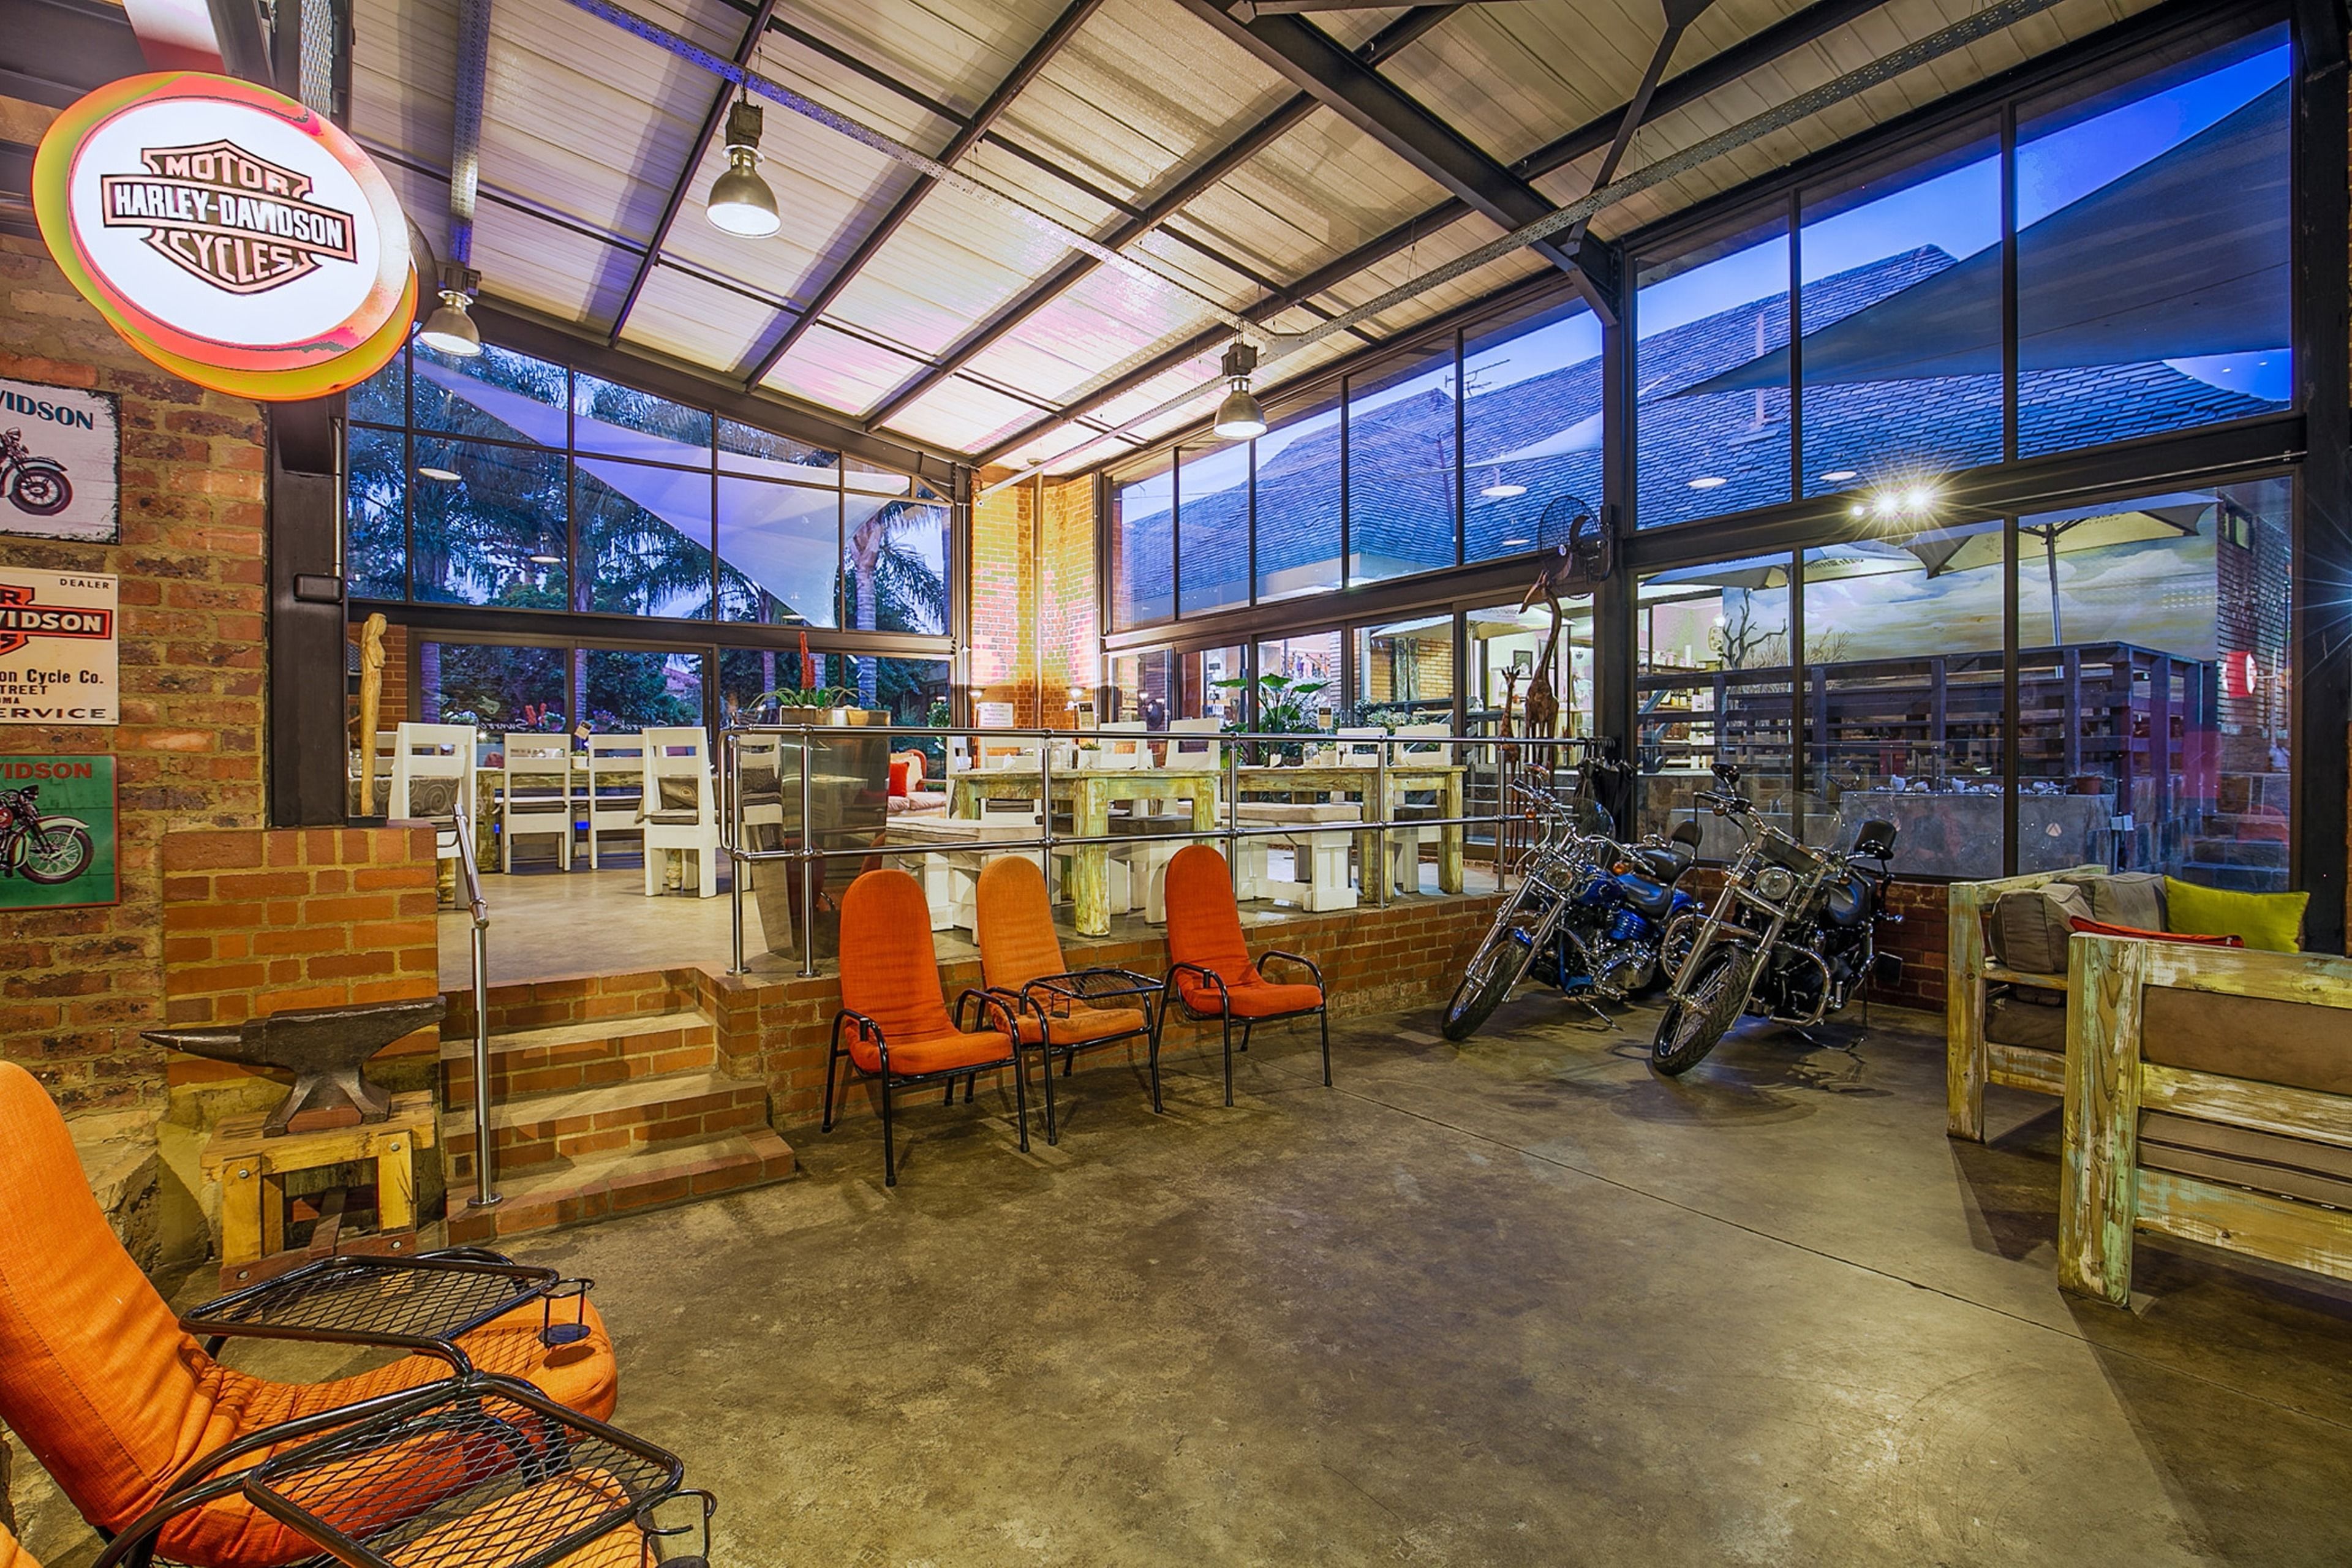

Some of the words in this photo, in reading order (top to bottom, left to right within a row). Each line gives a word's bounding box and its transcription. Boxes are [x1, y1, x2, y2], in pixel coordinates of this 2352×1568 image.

[165, 153, 290, 194] MOTOR
[115, 183, 345, 249] HARLEY-DAVIDSON
[167, 230, 296, 283] CYCLES
[59, 578, 110, 589] DEALER
[27, 669, 70, 684] Cycle
[80, 671, 104, 684] Co.
